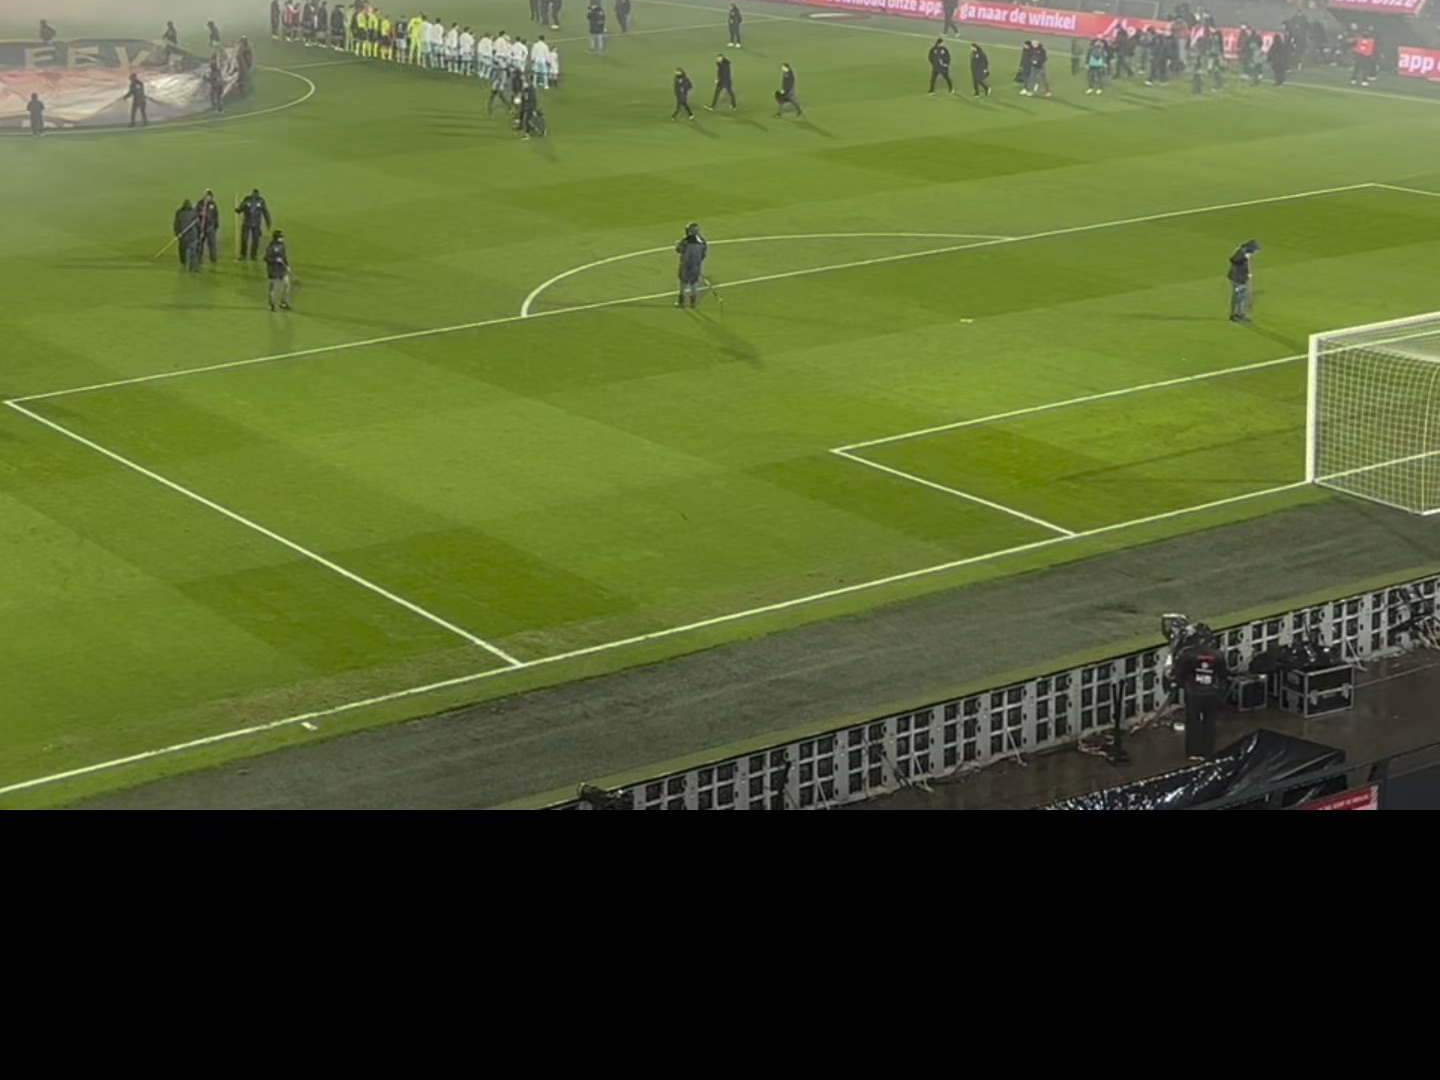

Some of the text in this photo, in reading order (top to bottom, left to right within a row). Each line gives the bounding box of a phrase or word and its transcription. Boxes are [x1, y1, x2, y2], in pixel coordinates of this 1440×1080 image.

[960, 3, 1077, 31] ga naar de winkel
[1398, 52, 1435, 75] app
